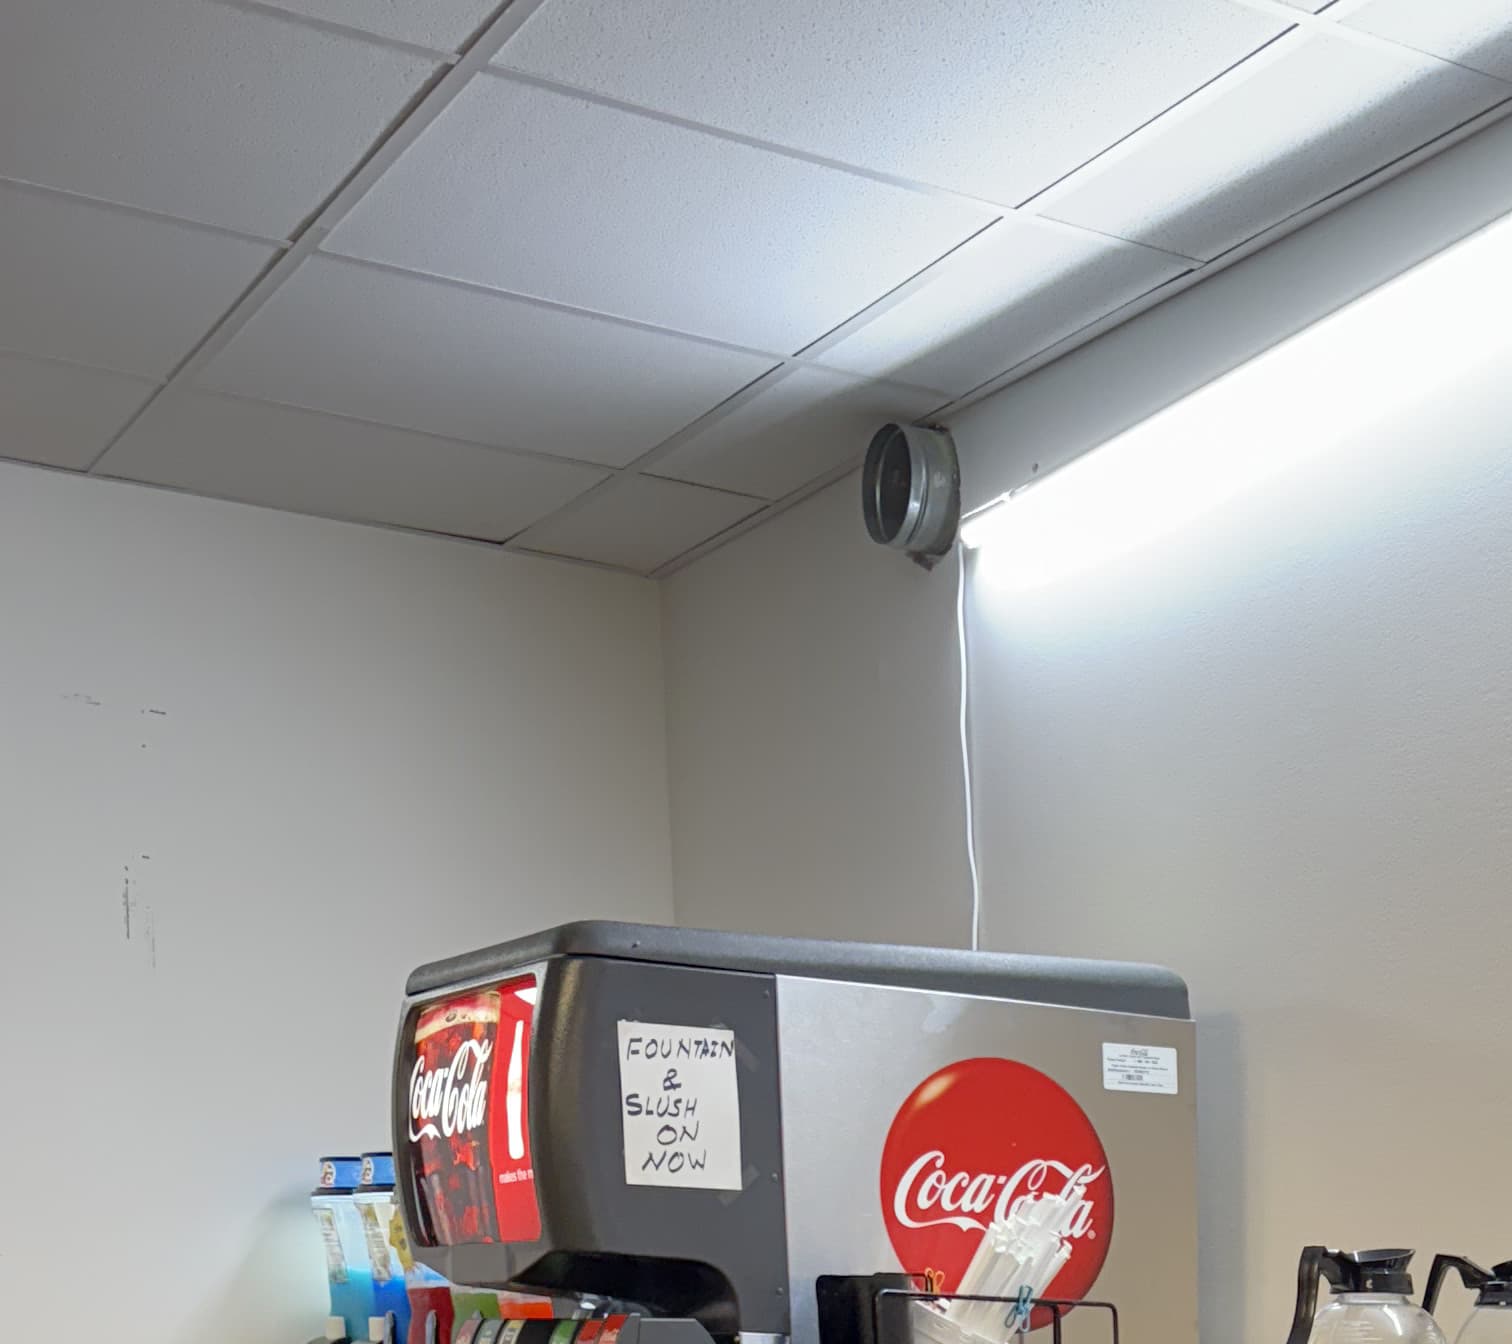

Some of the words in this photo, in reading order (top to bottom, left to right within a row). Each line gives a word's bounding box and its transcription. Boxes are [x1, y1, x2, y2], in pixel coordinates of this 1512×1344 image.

[626, 1036, 735, 1061] FOUNTAIN
[409, 1038, 493, 1142] Coca-Cola
[663, 1067, 682, 1091] &
[625, 1093, 697, 1118] SLUSH
[656, 1120, 700, 1145] ON
[641, 1148, 707, 1173] NOW
[894, 1150, 1106, 1239] Coca-Cla
